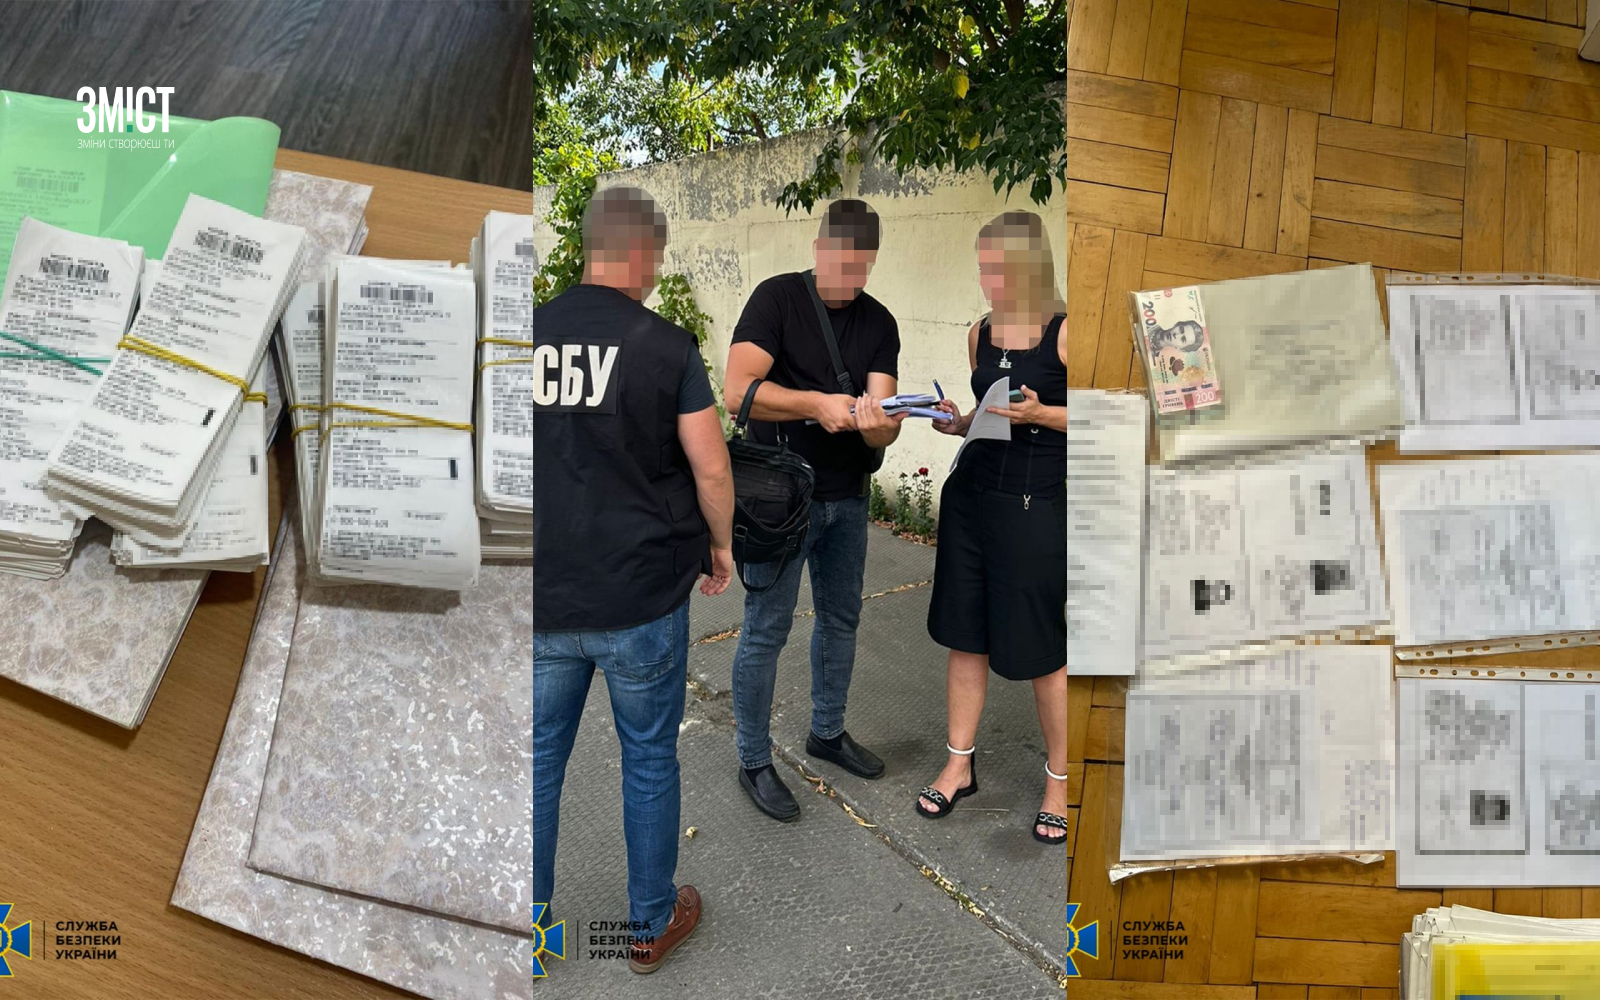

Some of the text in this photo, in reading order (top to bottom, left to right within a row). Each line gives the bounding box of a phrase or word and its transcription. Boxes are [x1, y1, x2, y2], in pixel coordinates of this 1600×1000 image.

[1142, 301, 1157, 326] 200
[533, 344, 620, 407] СБУ
[1195, 391, 1214, 403] 200
